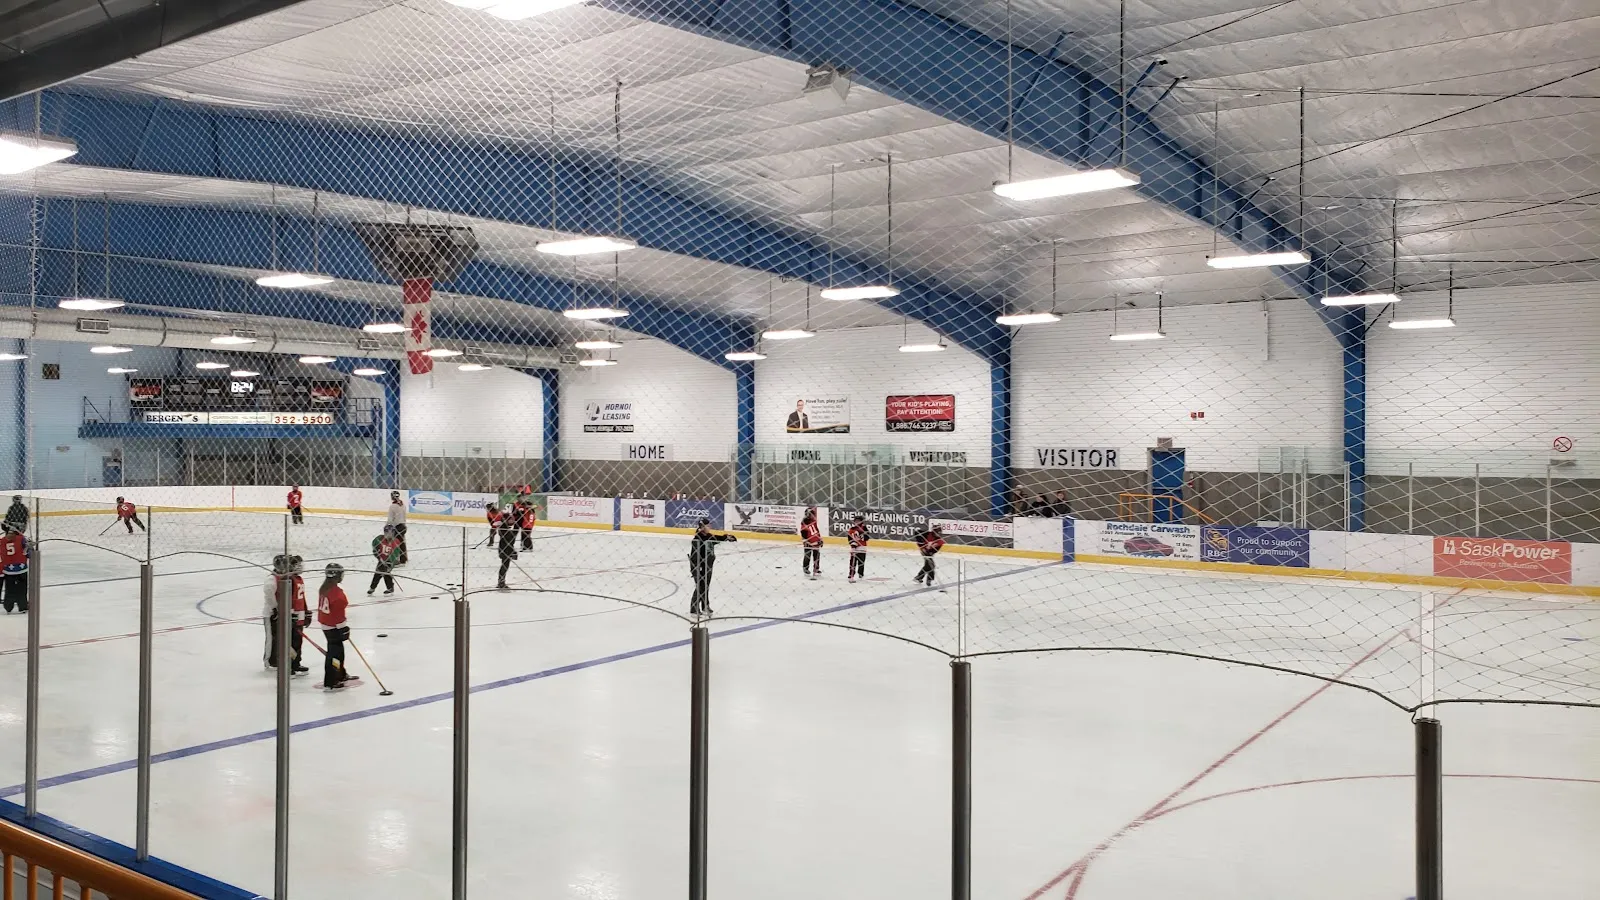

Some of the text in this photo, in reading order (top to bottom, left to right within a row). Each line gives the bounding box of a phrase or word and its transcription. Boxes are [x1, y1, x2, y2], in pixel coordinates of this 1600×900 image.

[601, 412, 631, 421] LEASING
[629, 445, 665, 459] HOME
[791, 449, 821, 461] HOME
[909, 450, 967, 463] VISITORS
[1036, 448, 1117, 467] VISITOR
[832, 511, 840, 519] A
[865, 512, 910, 523] MEANING
[912, 515, 925, 524] TO
[833, 522, 856, 532] FRO
[1106, 522, 1191, 533] Rochdale Carwash
[1237, 536, 1259, 545] Proud
[1271, 539, 1302, 548] support
[6, 543, 15, 555] 5
[1207, 549, 1228, 558] RBC
[1255, 548, 1299, 558] community
[1459, 540, 1560, 560] SaskPower
[1459, 559, 1497, 568] Powering
